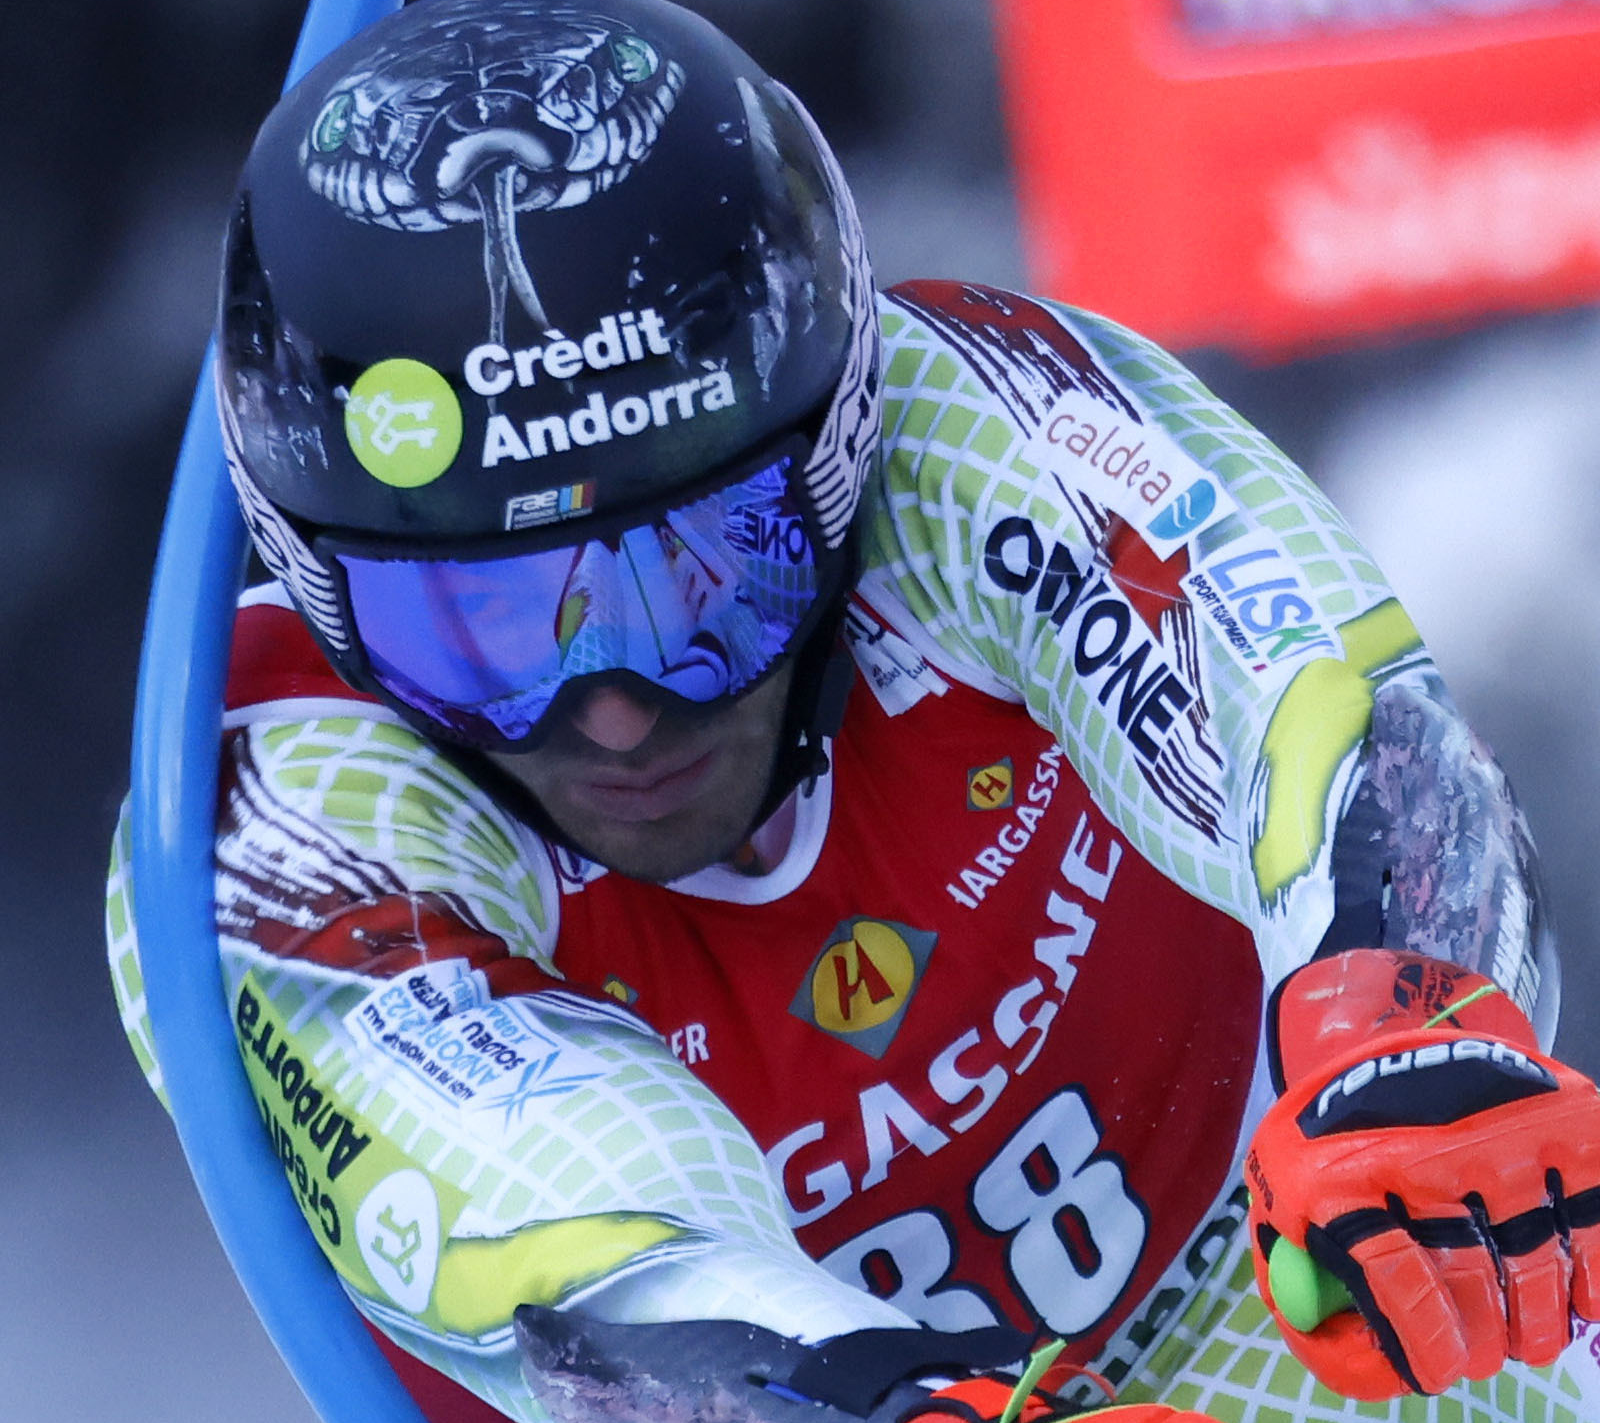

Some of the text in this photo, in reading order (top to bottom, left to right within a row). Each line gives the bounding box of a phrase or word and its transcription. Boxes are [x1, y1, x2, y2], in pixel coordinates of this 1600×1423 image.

[463, 308, 672, 396] Crèdit
[481, 358, 736, 468] Andorrà
[1046, 410, 1172, 506] caldea
[1188, 574, 1221, 607] SPORT
